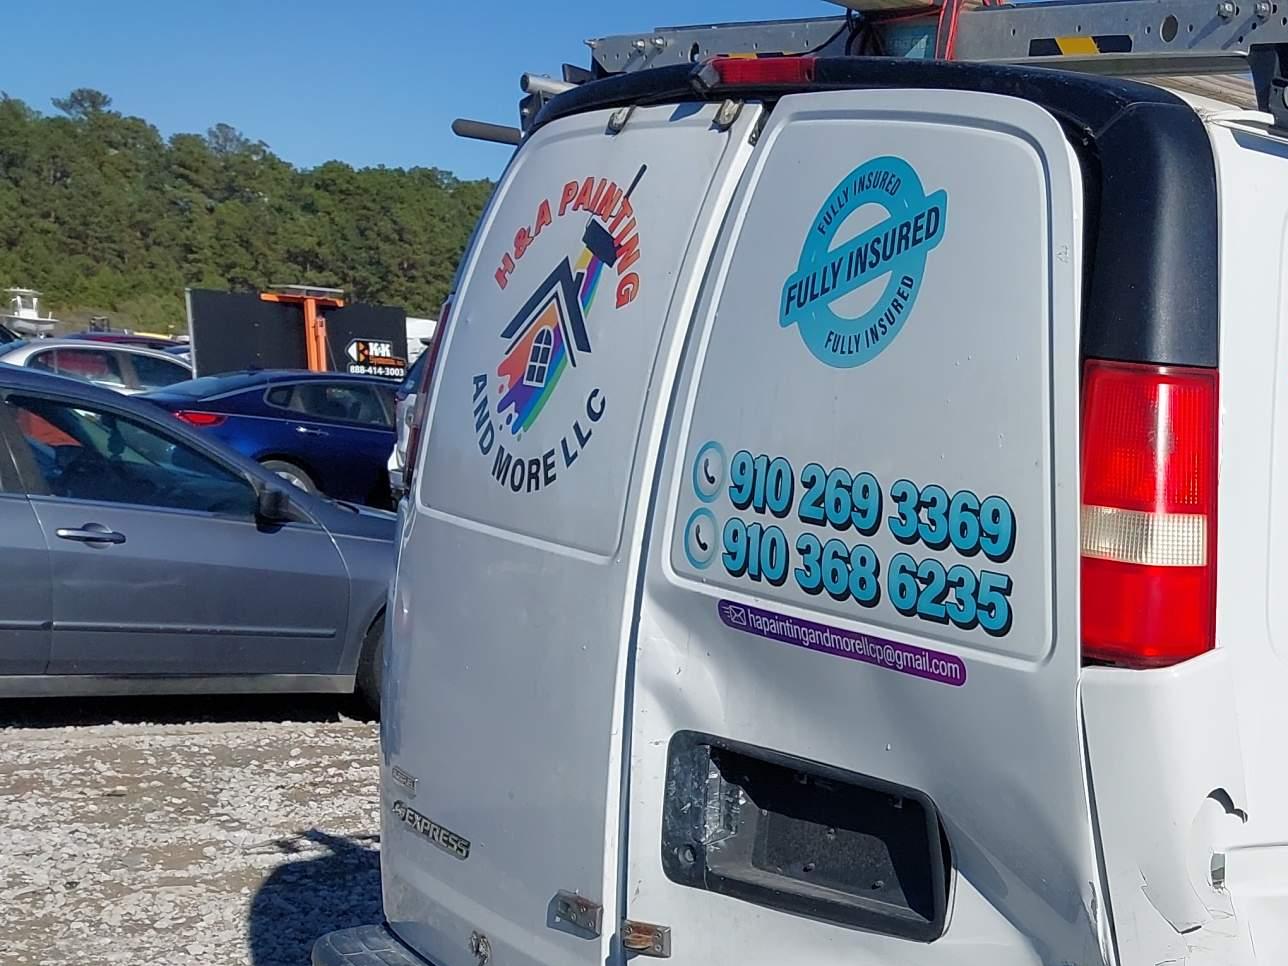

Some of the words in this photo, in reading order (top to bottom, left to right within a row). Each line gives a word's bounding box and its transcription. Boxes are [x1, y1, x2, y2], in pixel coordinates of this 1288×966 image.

[494, 199, 552, 289] H&A
[558, 177, 640, 309] PAINTING
[817, 187, 849, 235] FULLY
[853, 170, 901, 196] INSURED
[785, 256, 843, 316] FULLY
[846, 206, 940, 282] INSURED
[824, 330, 861, 355] FULLY
[866, 275, 914, 348] INSURED
[350, 365, 404, 376] 888-414-3003
[472, 373, 495, 455] AND
[492, 444, 556, 492] MORE
[560, 388, 606, 468] LLC
[729, 450, 794, 518] 910
[798, 463, 882, 536] 269
[888, 479, 1016, 563] 3369
[722, 517, 789, 586] 910
[794, 532, 881, 608] 368
[888, 553, 1014, 637] 6235
[748, 609, 960, 680] hapaintingandmorellcp@gmail.com
[404, 807, 471, 859] EXPRESS
